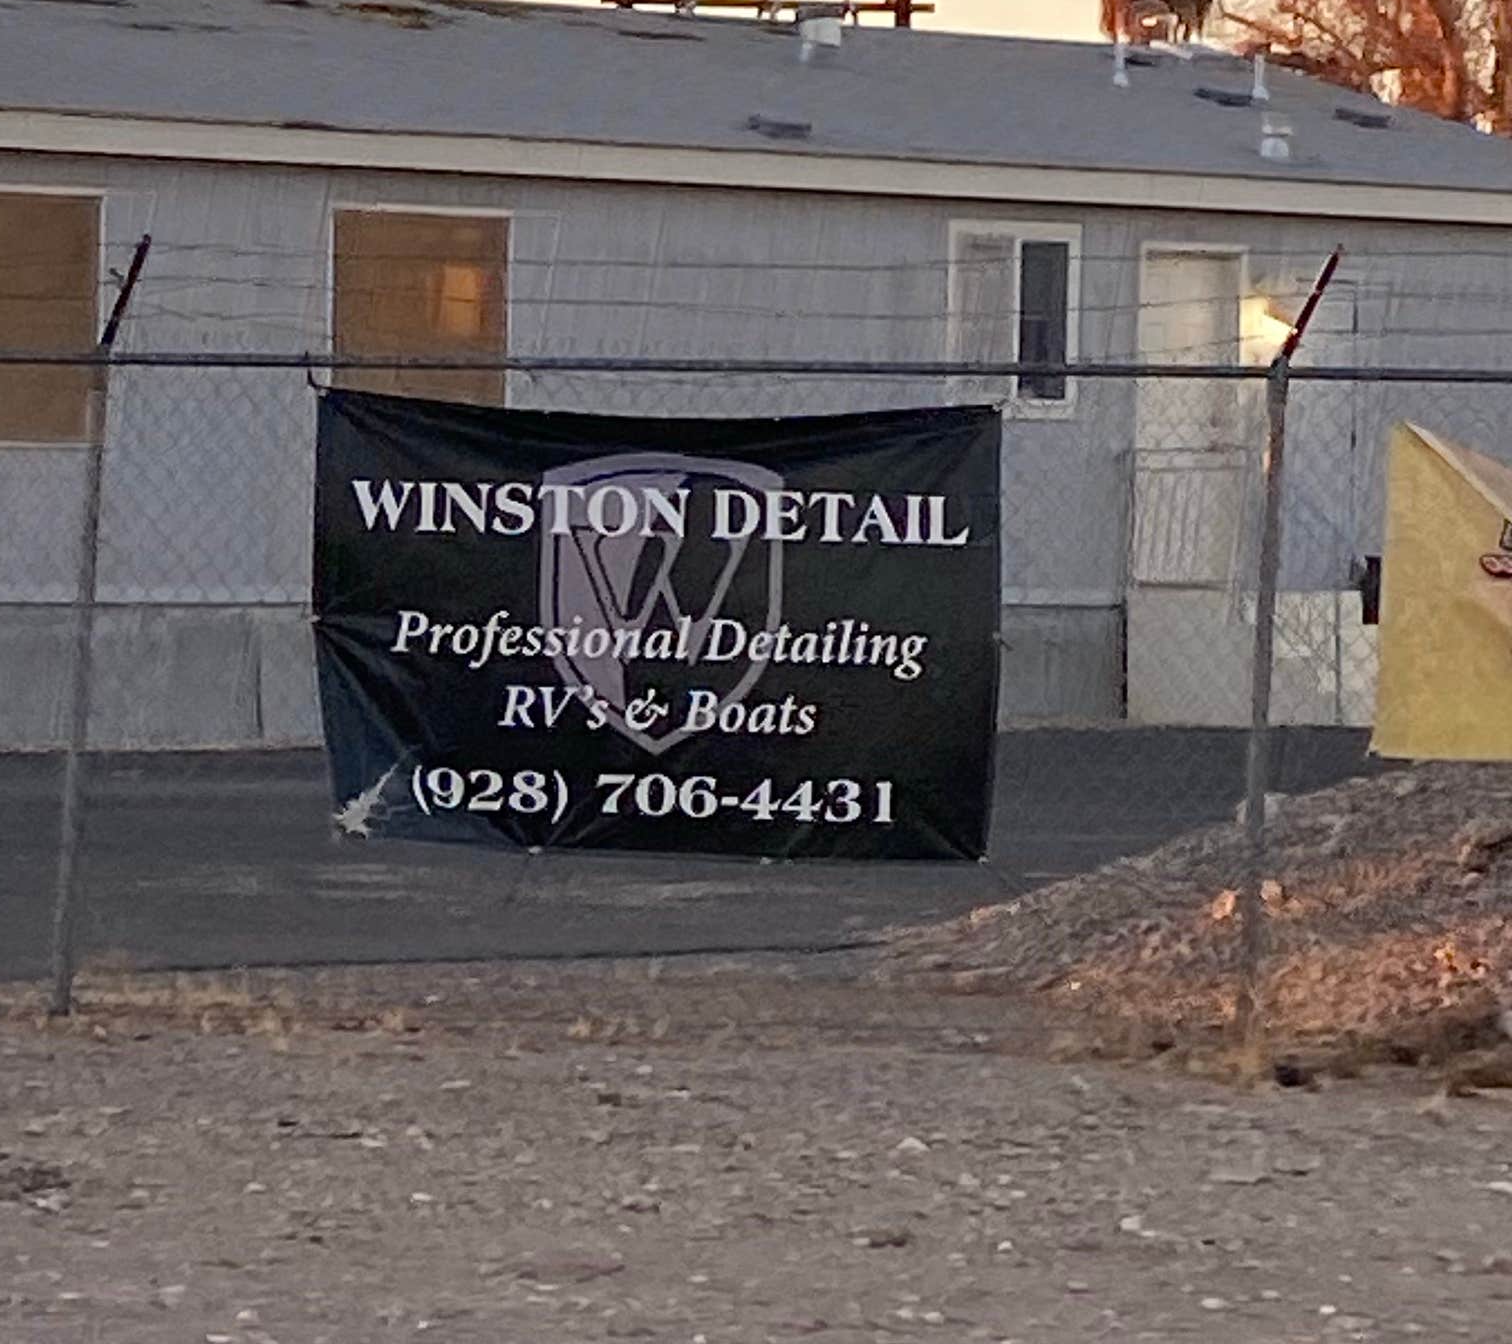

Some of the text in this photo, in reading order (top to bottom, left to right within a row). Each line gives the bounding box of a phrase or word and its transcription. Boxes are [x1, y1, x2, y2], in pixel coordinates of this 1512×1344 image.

[351, 479, 969, 546] WINSTON DETAIL
[390, 609, 928, 680] Professional Detailing
[498, 684, 817, 735] RV's & Boats
[410, 766, 894, 825] (928) 706-4431
